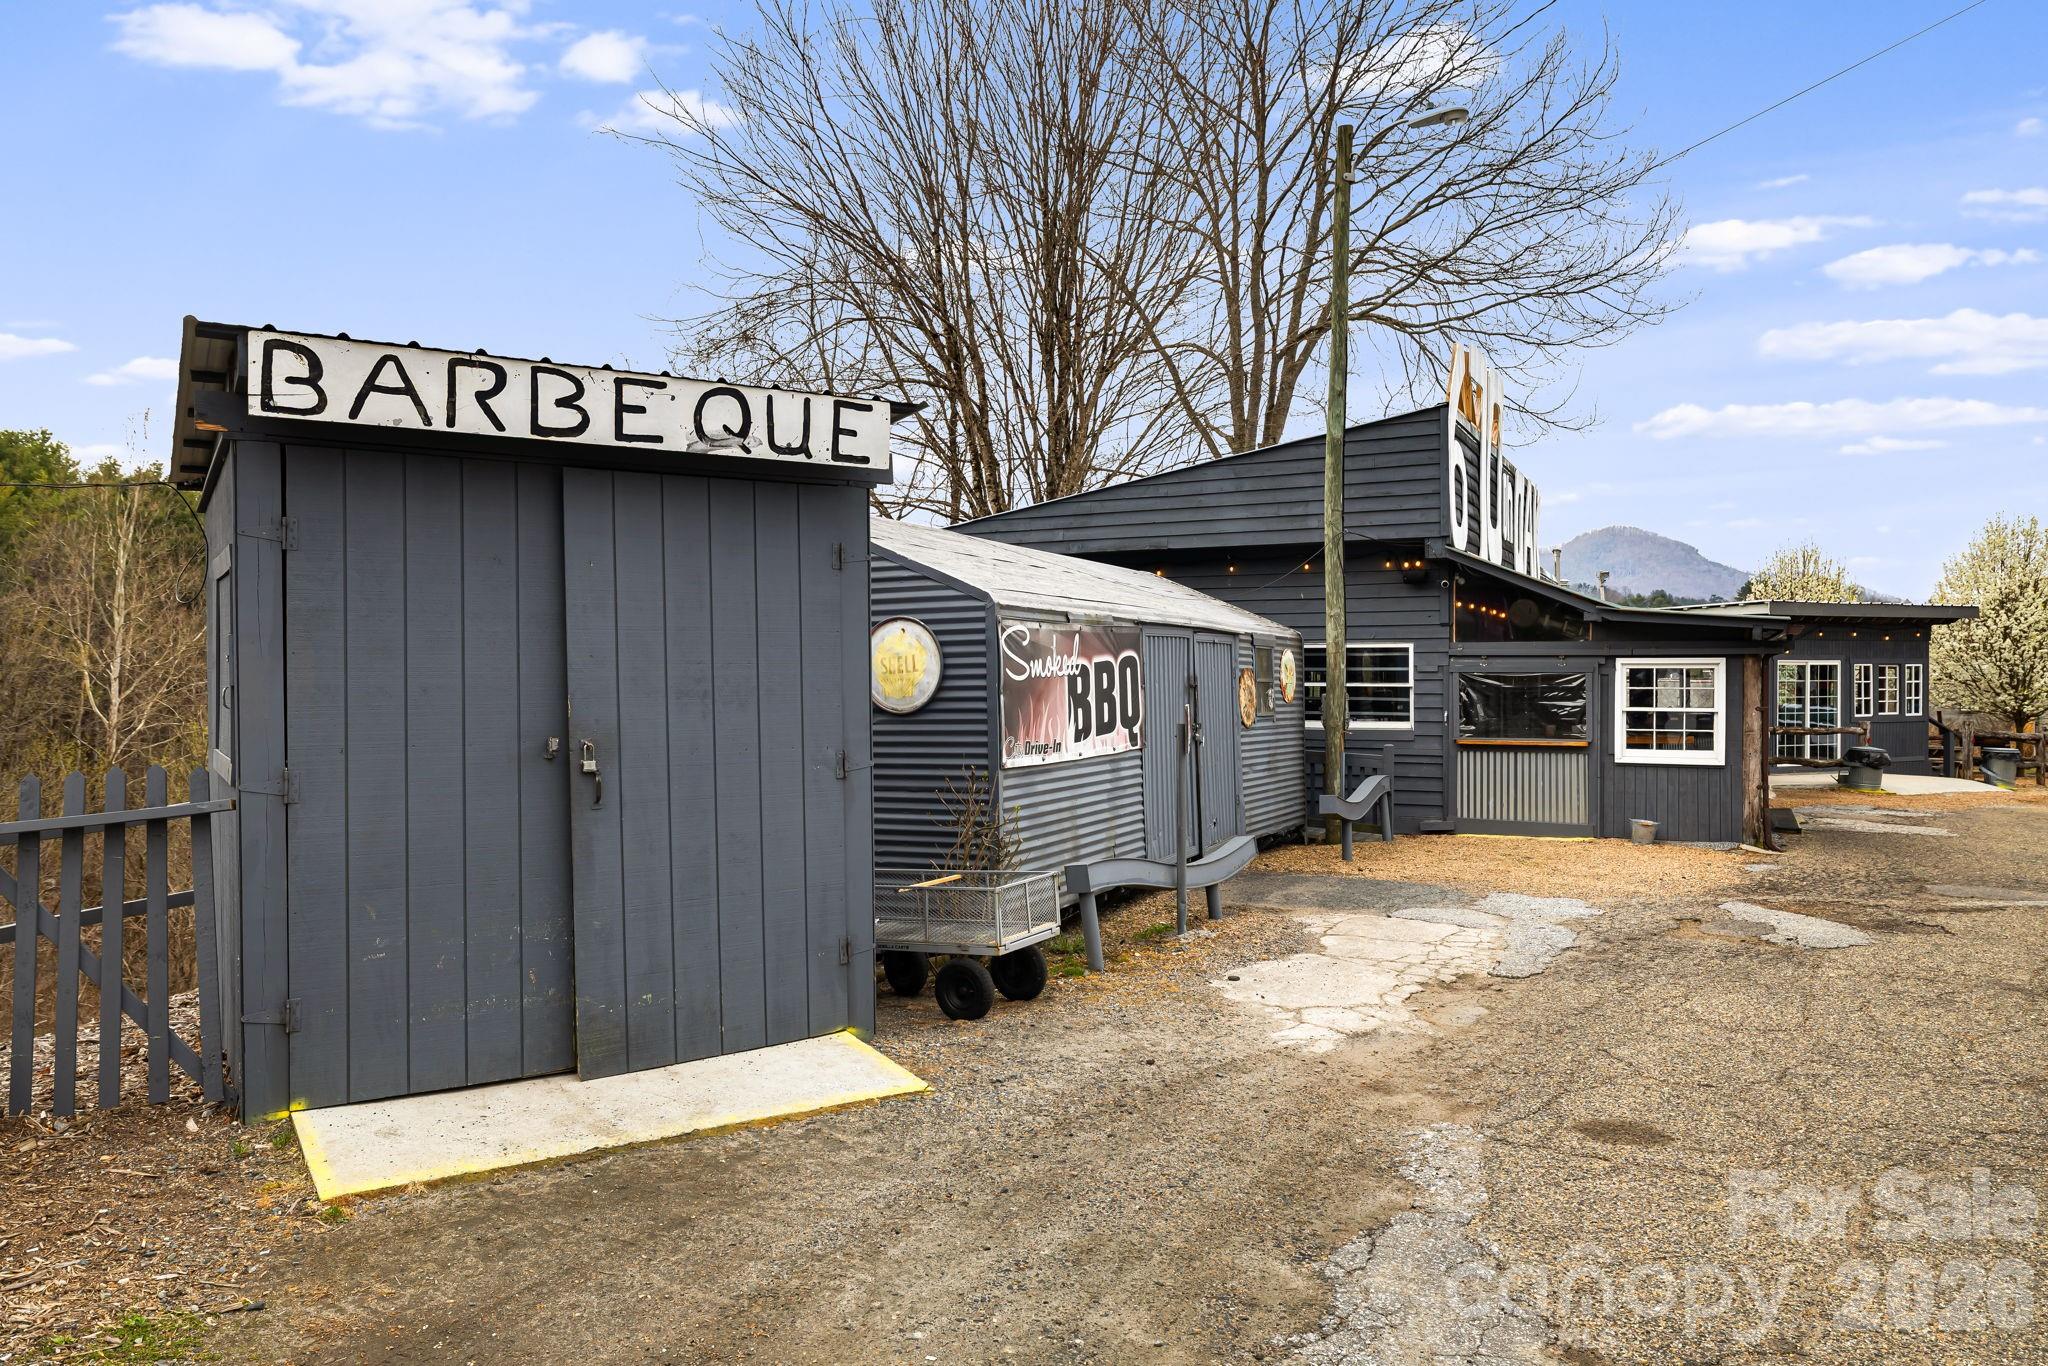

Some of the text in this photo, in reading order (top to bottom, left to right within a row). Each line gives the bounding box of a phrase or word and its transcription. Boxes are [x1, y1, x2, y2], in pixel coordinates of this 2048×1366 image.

[261, 339, 872, 464] BARBEQUE
[1001, 625, 1081, 681] Smoked
[1067, 655, 1141, 747] BBQ
[1024, 740, 1062, 756] Drive-In
